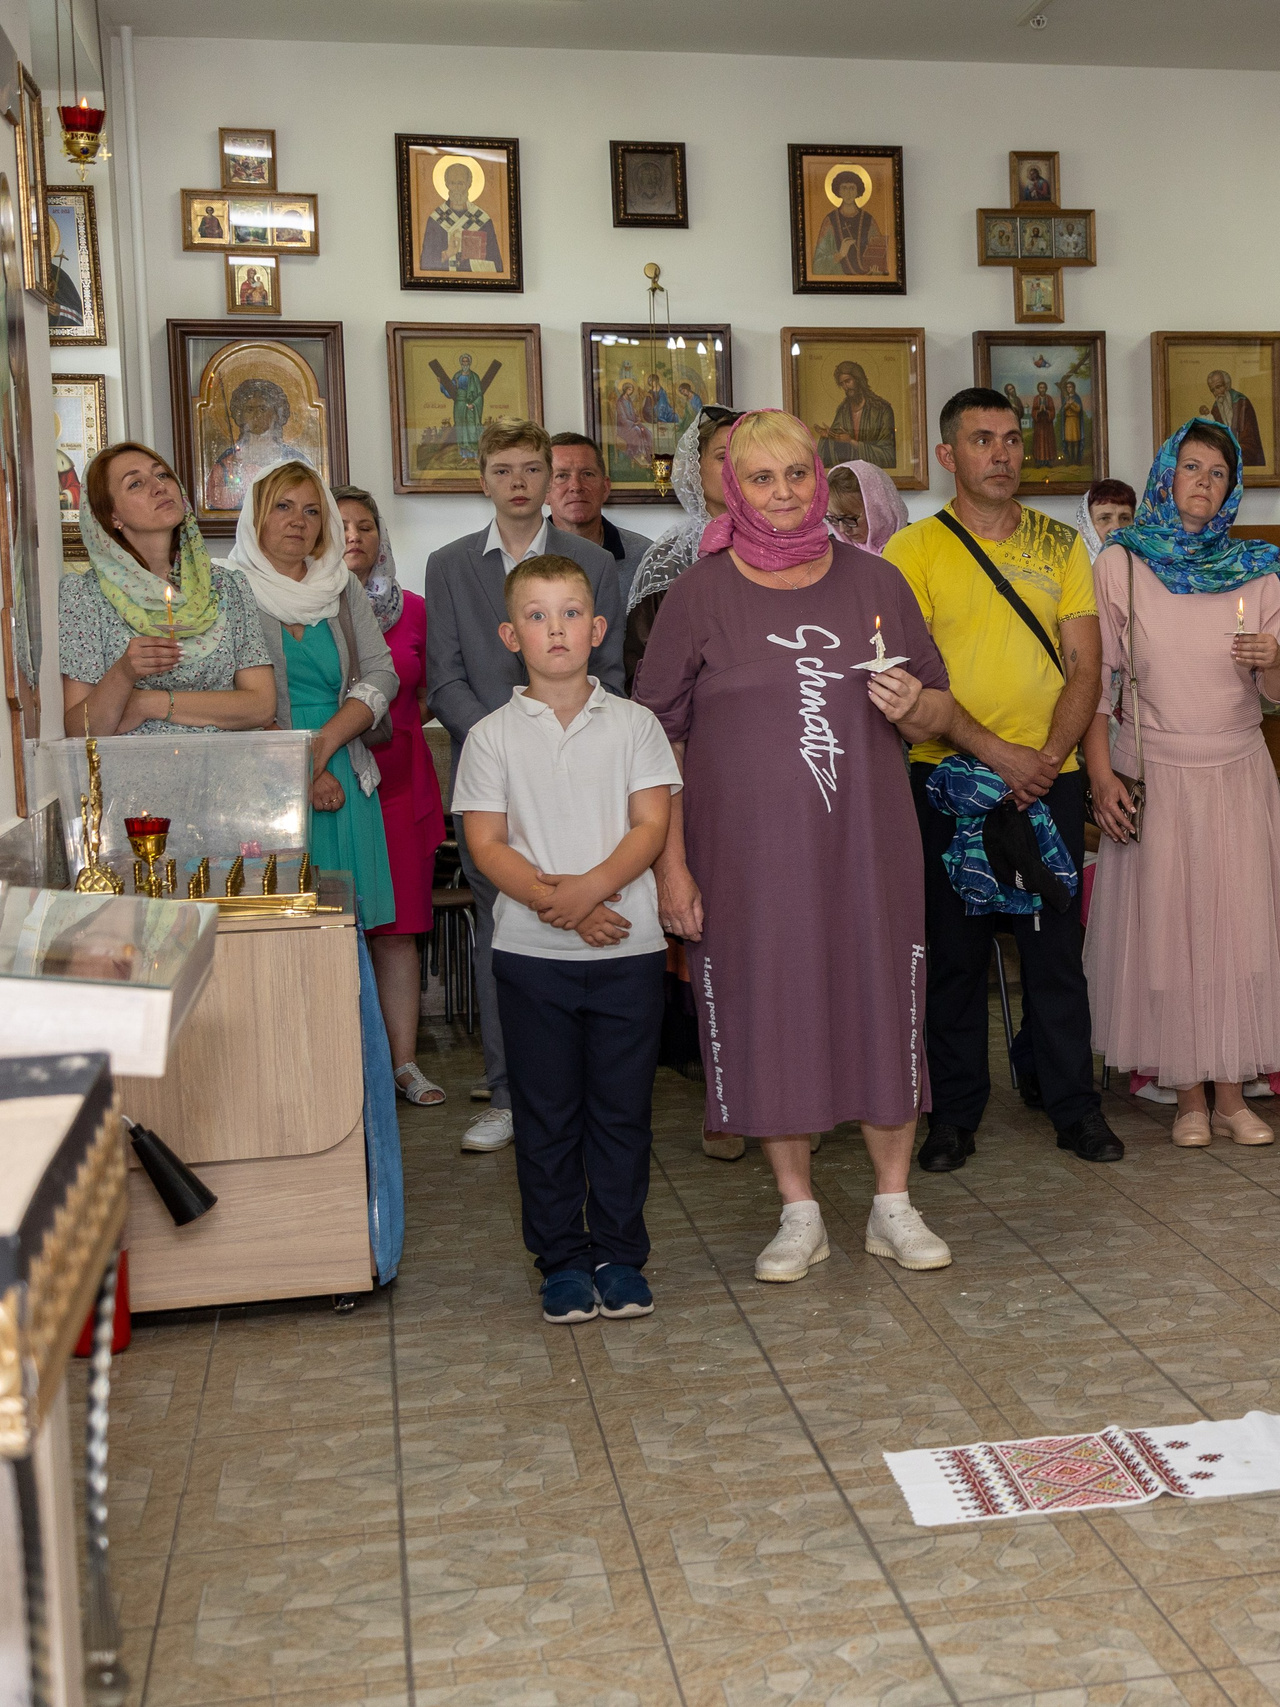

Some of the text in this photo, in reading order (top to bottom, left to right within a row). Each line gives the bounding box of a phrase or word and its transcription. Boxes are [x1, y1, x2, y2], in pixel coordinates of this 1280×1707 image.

[911, 943, 925, 987] Happy
[703, 956, 714, 999] Happy
[715, 1065, 724, 1101] happy
